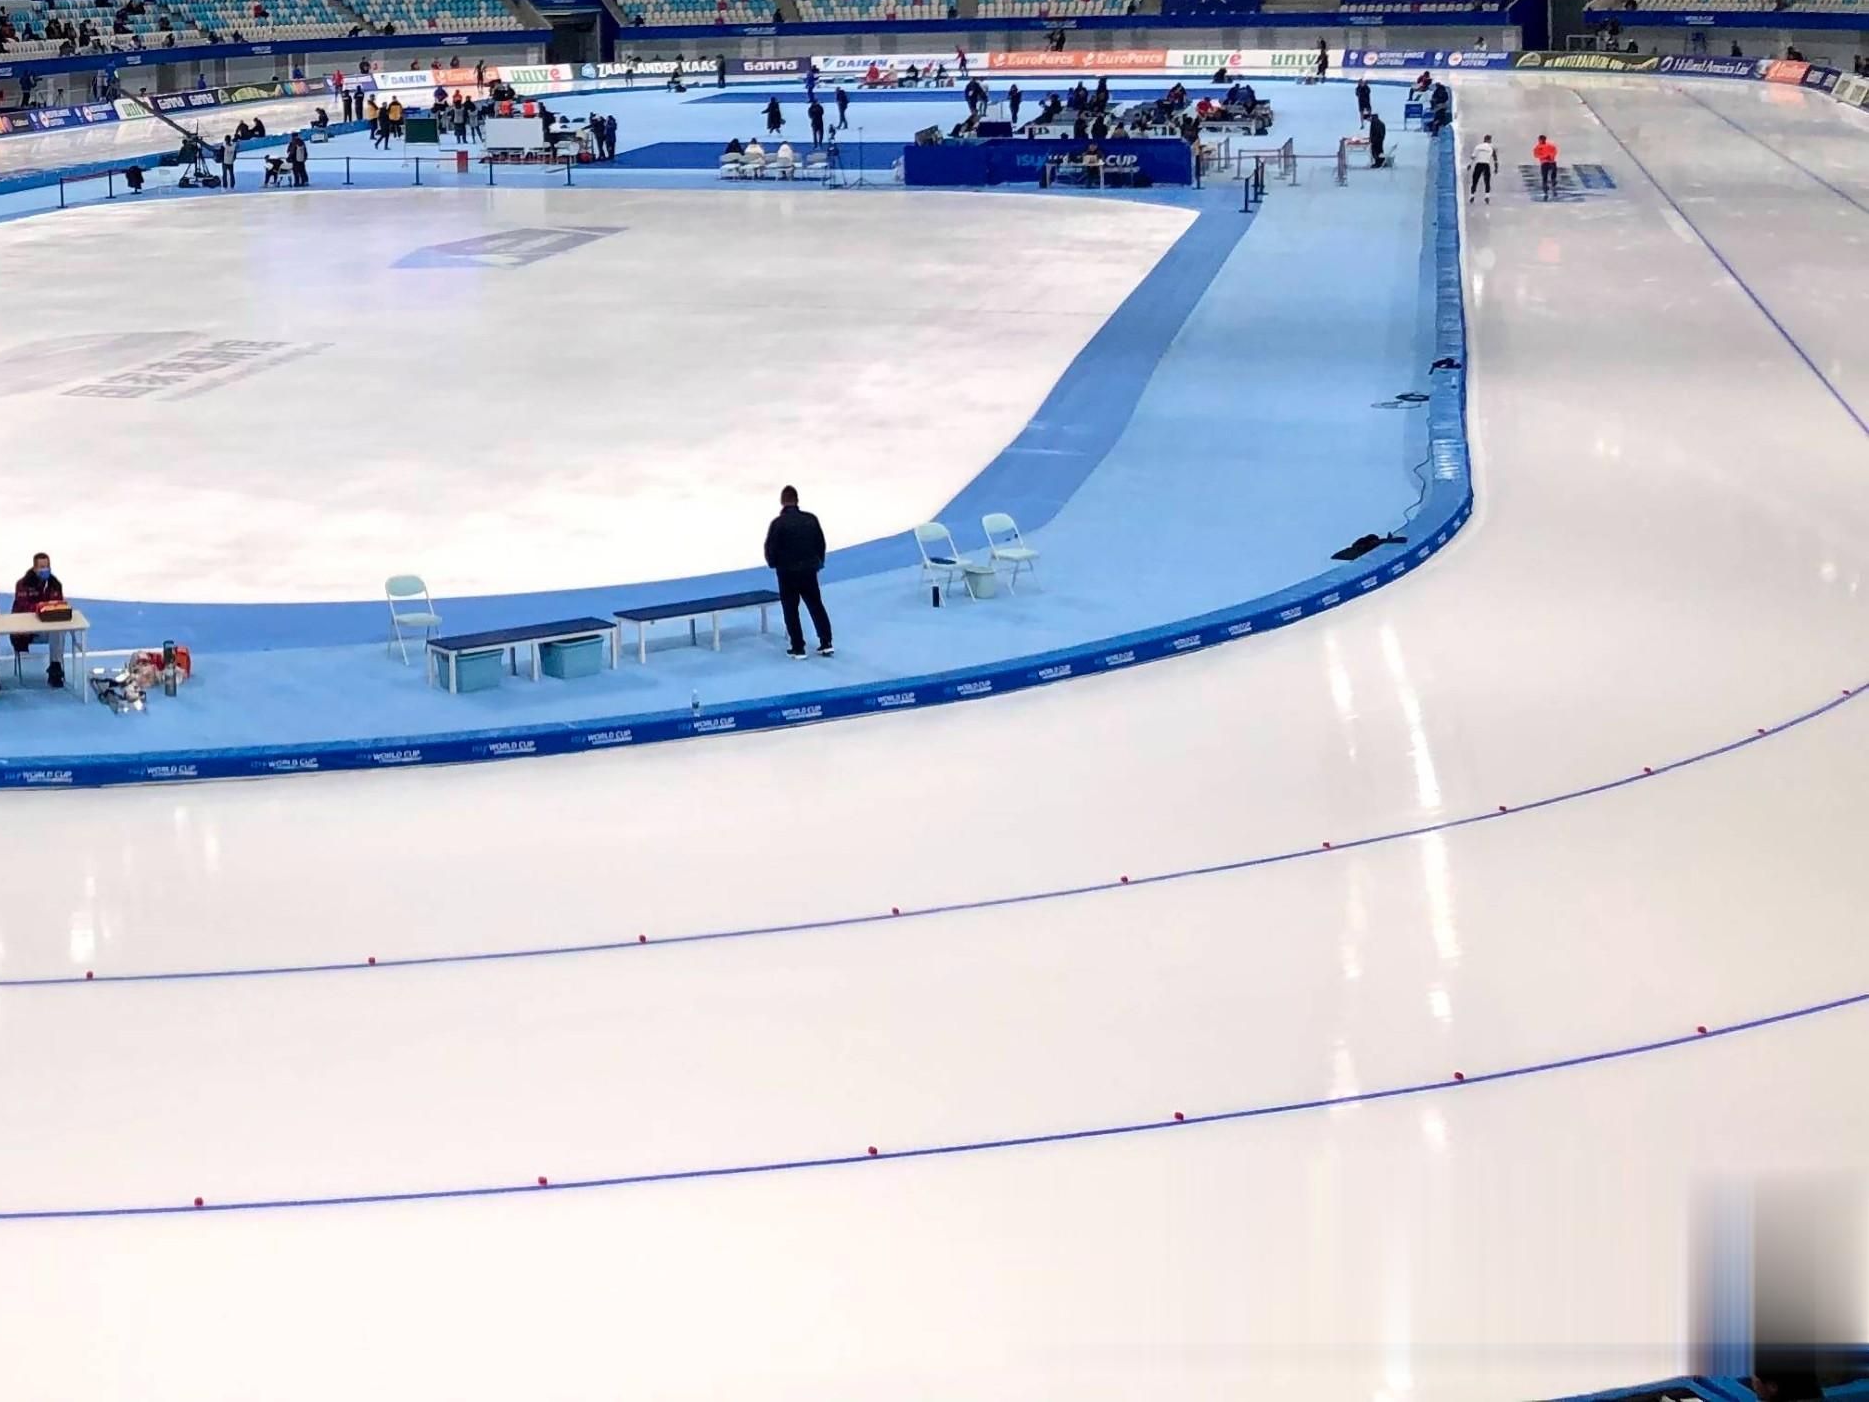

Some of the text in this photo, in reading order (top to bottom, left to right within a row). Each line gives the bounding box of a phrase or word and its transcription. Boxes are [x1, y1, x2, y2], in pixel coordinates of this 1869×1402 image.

[681, 60, 717, 73] KAAS
[390, 75, 427, 85] DAIKIN
[1105, 154, 1138, 166] CUP
